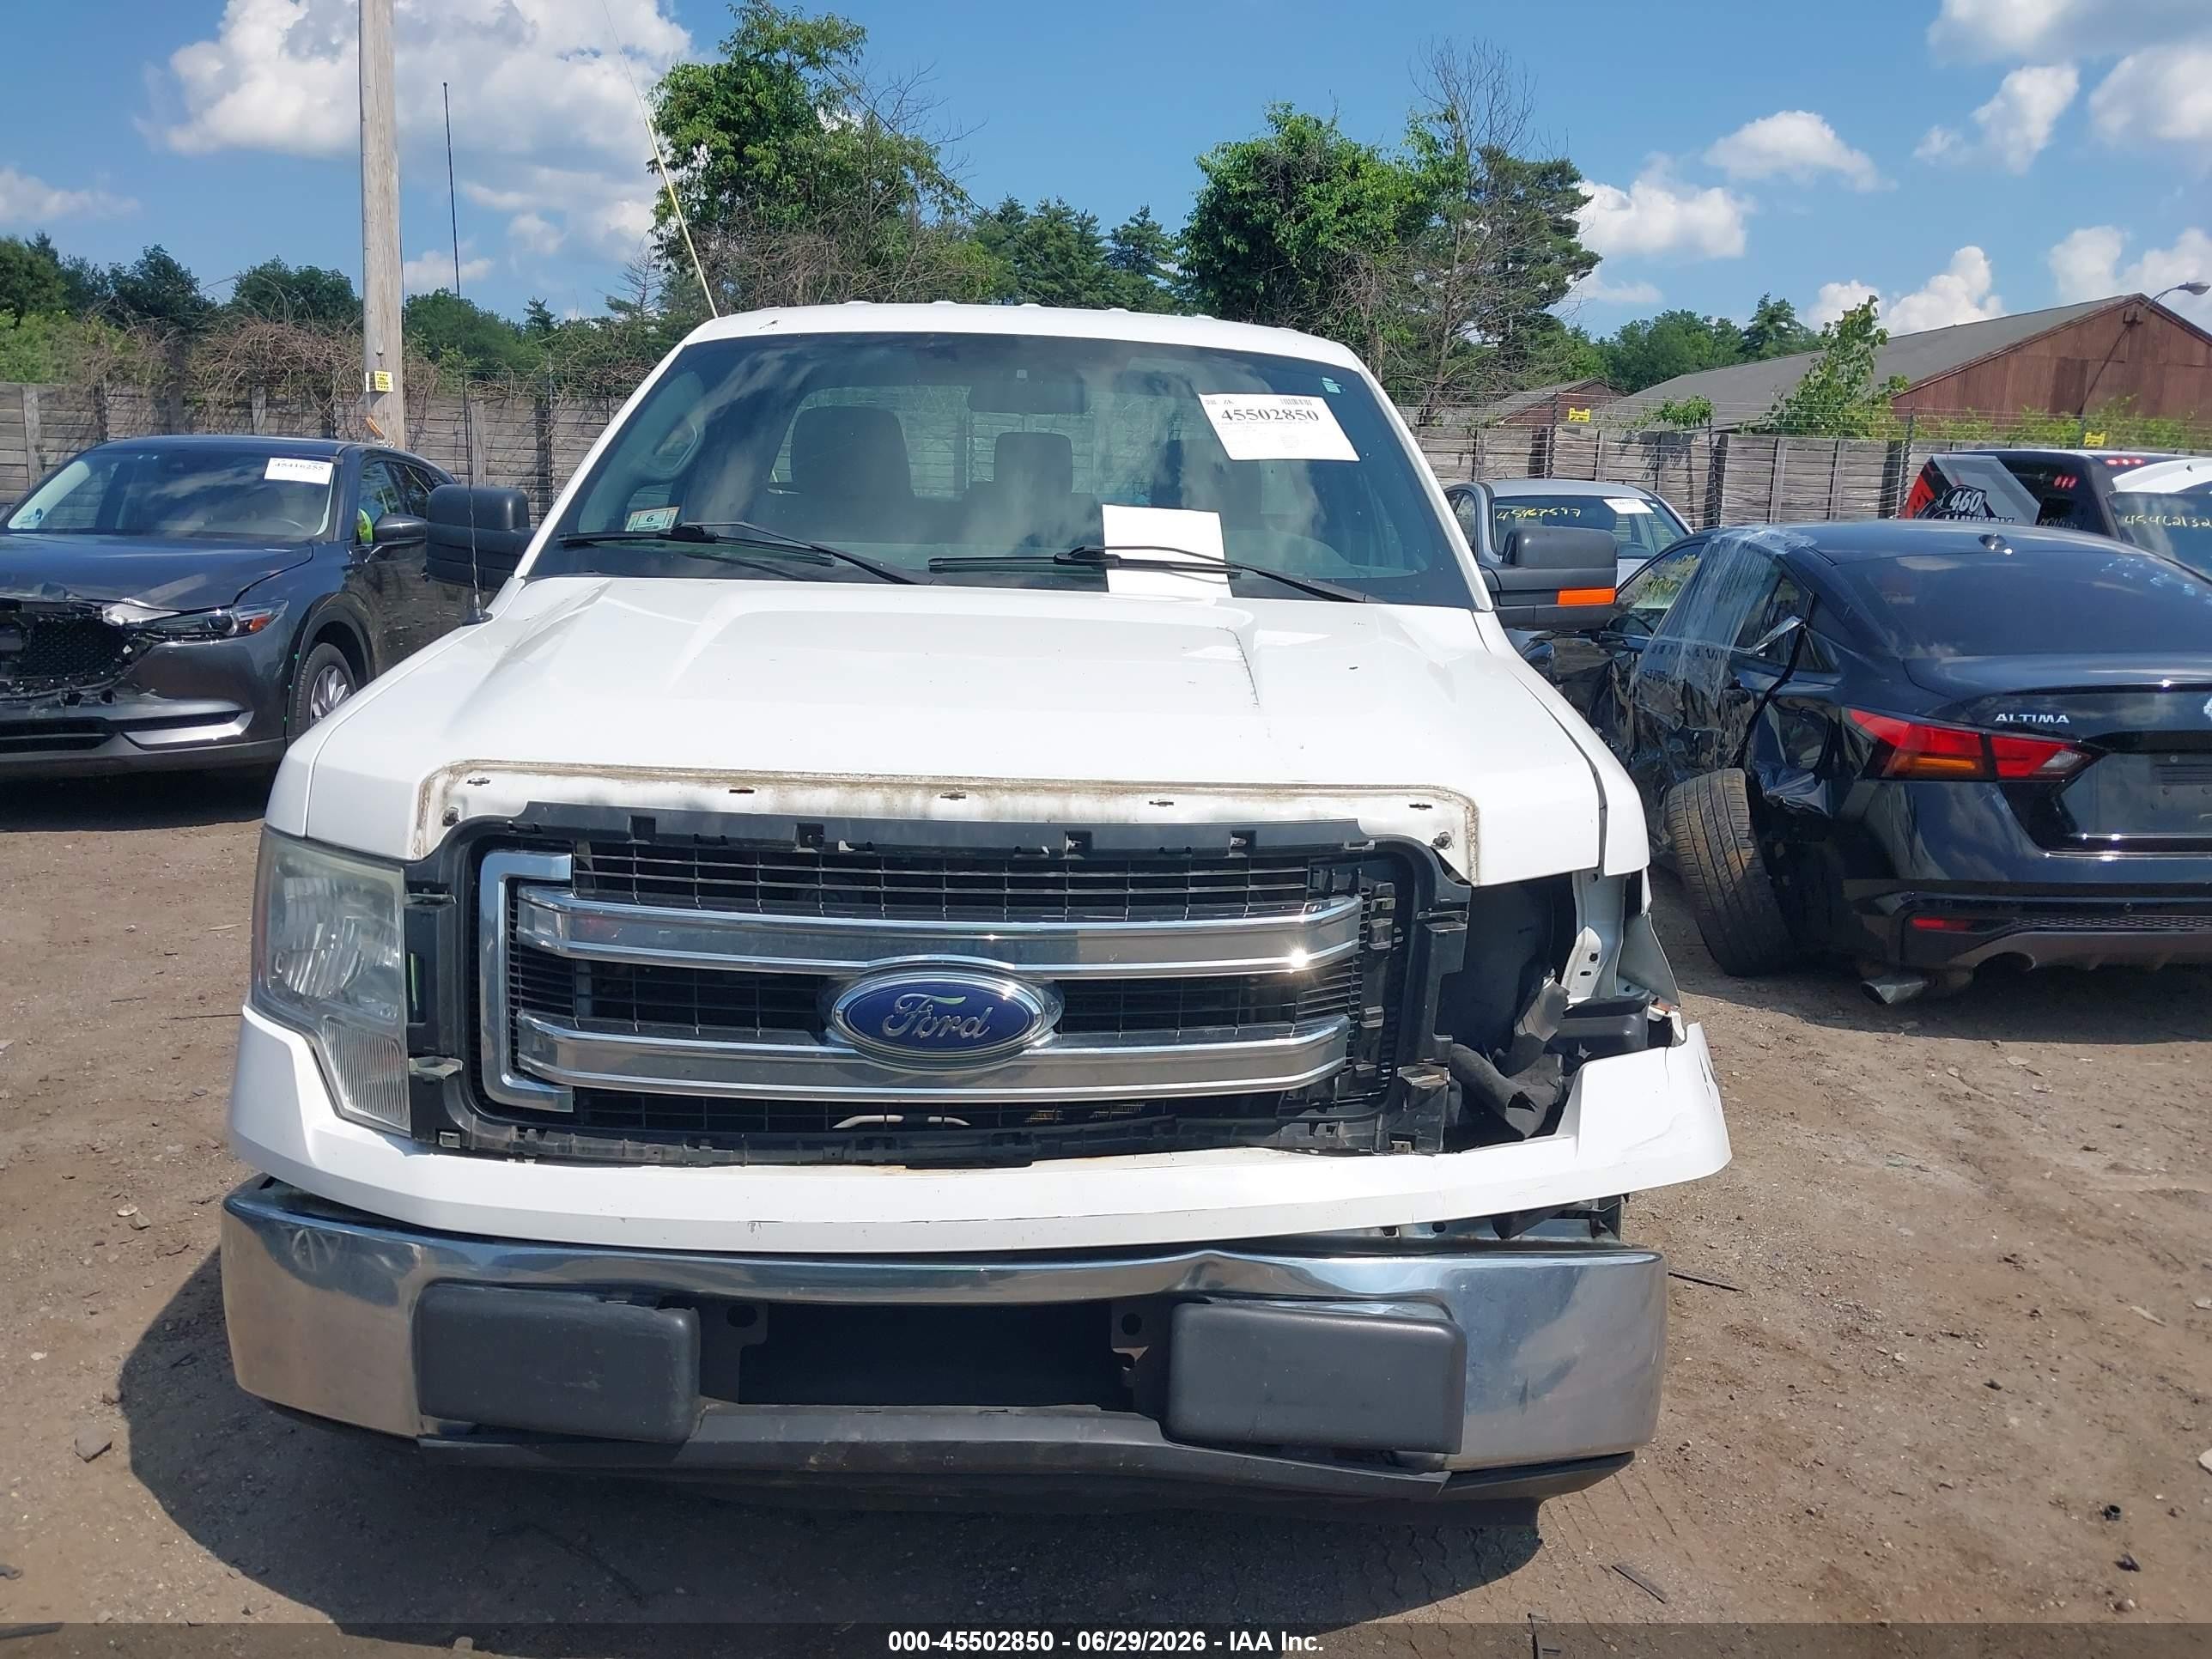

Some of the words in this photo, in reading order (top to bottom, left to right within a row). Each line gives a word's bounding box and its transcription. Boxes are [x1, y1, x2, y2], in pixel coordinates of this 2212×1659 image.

[1221, 408, 1320, 422] 45502850
[1948, 490, 1984, 512] 460
[1995, 713, 2070, 724] ALTIMA
[882, 993, 995, 1040] Ford
